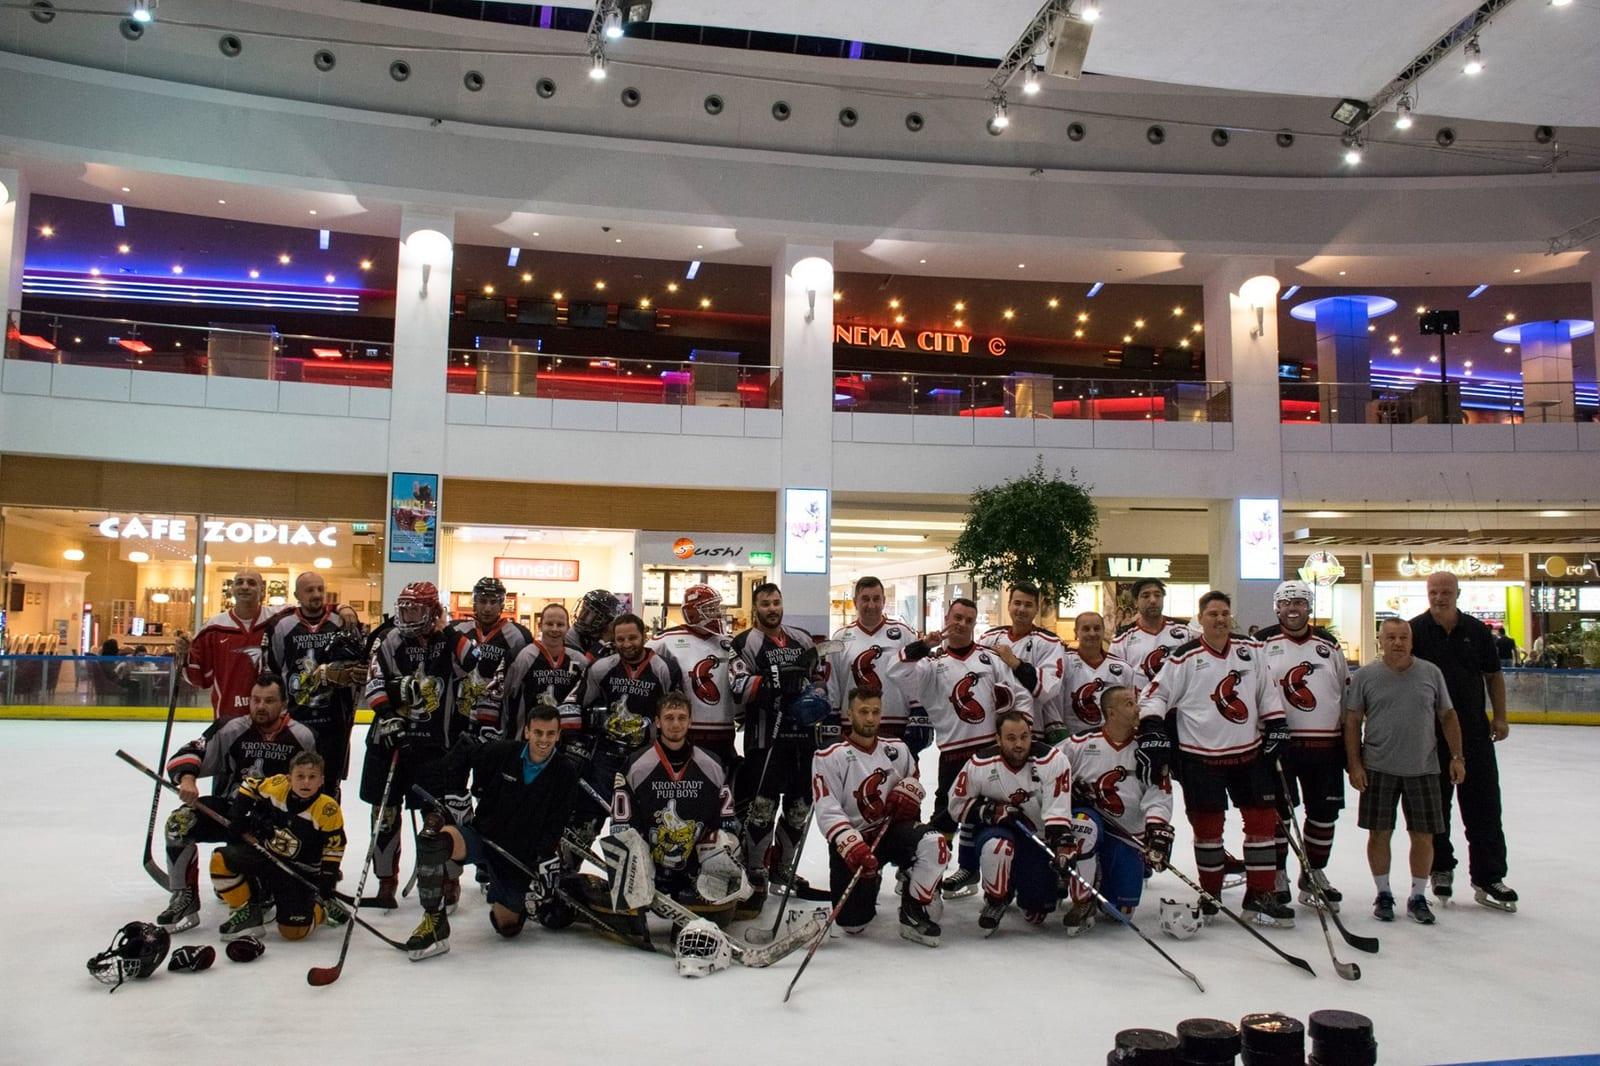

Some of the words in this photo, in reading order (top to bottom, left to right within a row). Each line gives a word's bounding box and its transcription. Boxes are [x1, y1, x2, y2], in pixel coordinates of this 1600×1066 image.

[832, 324, 906, 348] NEMA
[917, 331, 973, 353] CITY
[98, 516, 186, 541] CAFE
[203, 521, 337, 547] ZODIAC
[608, 676, 656, 691] KRONSTADT
[629, 685, 650, 698] BOYS
[241, 741, 295, 754] KRONSTADT
[244, 749, 262, 759] PUB
[264, 750, 288, 761] BOYS
[651, 781, 704, 790] KRONSTADT
[656, 789, 675, 799] PUB
[676, 789, 698, 799] BOYS
